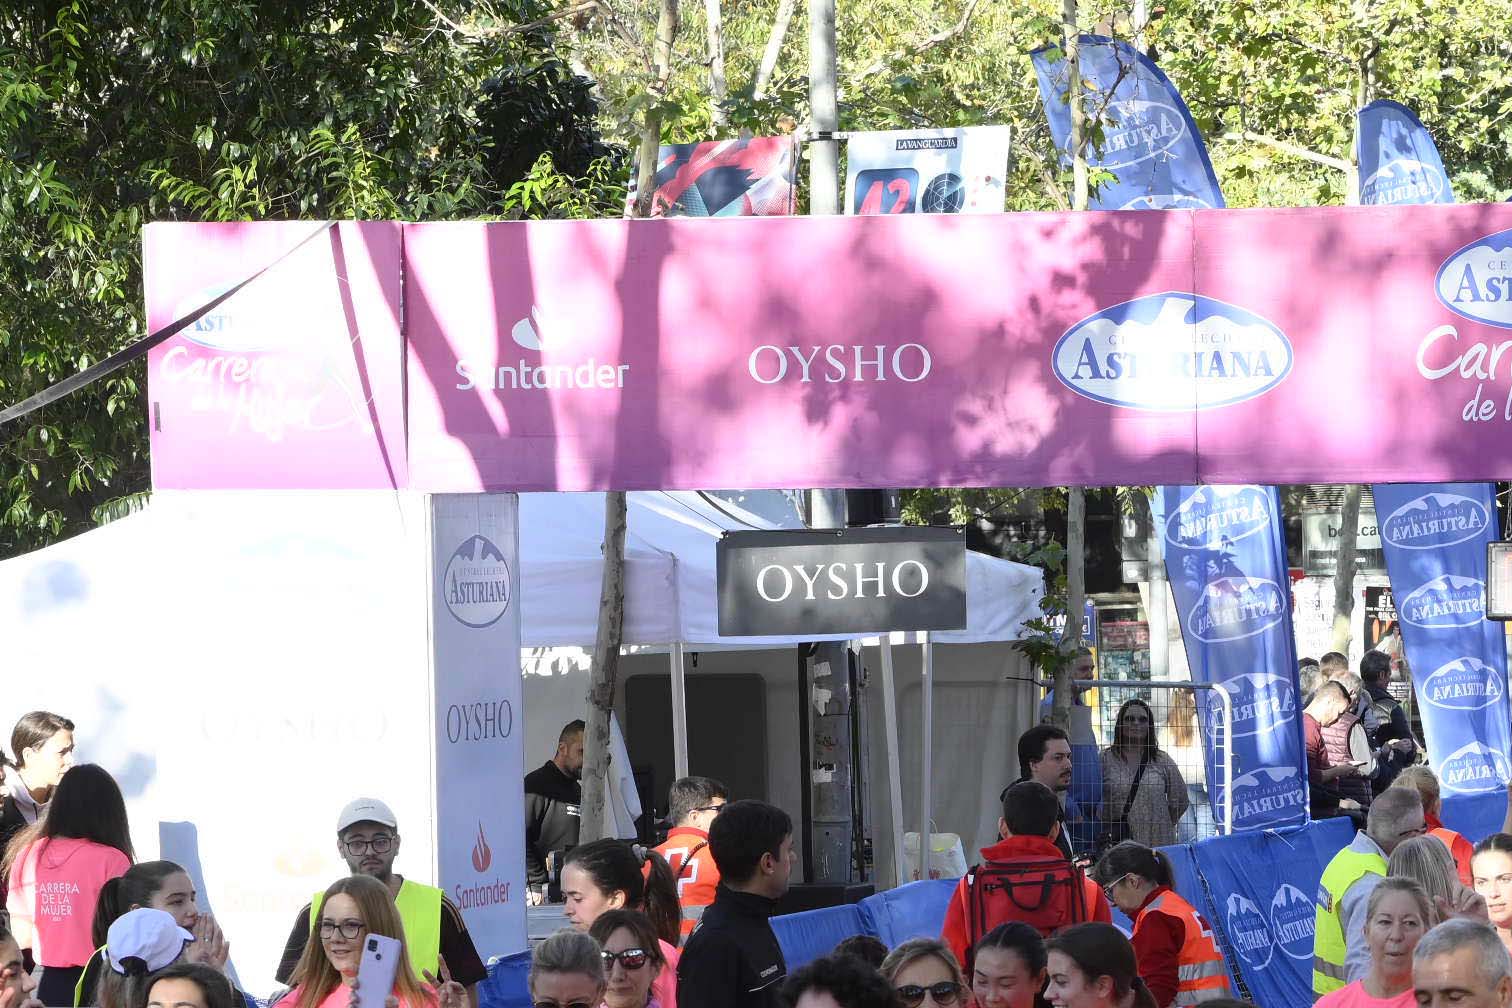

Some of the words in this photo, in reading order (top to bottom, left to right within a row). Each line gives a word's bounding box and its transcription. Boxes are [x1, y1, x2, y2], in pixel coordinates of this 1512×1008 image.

[455, 360, 630, 390] Santander
[748, 343, 933, 384] OYSHO
[1462, 384, 1498, 421] de
[450, 577, 507, 605] ASTURIANA
[755, 561, 930, 602] OYSHO
[447, 700, 512, 744] OYSHO
[40, 905, 72, 916] MUJER
[41, 893, 55, 905] DE
[57, 893, 70, 905] LA
[455, 878, 510, 912] Santander
